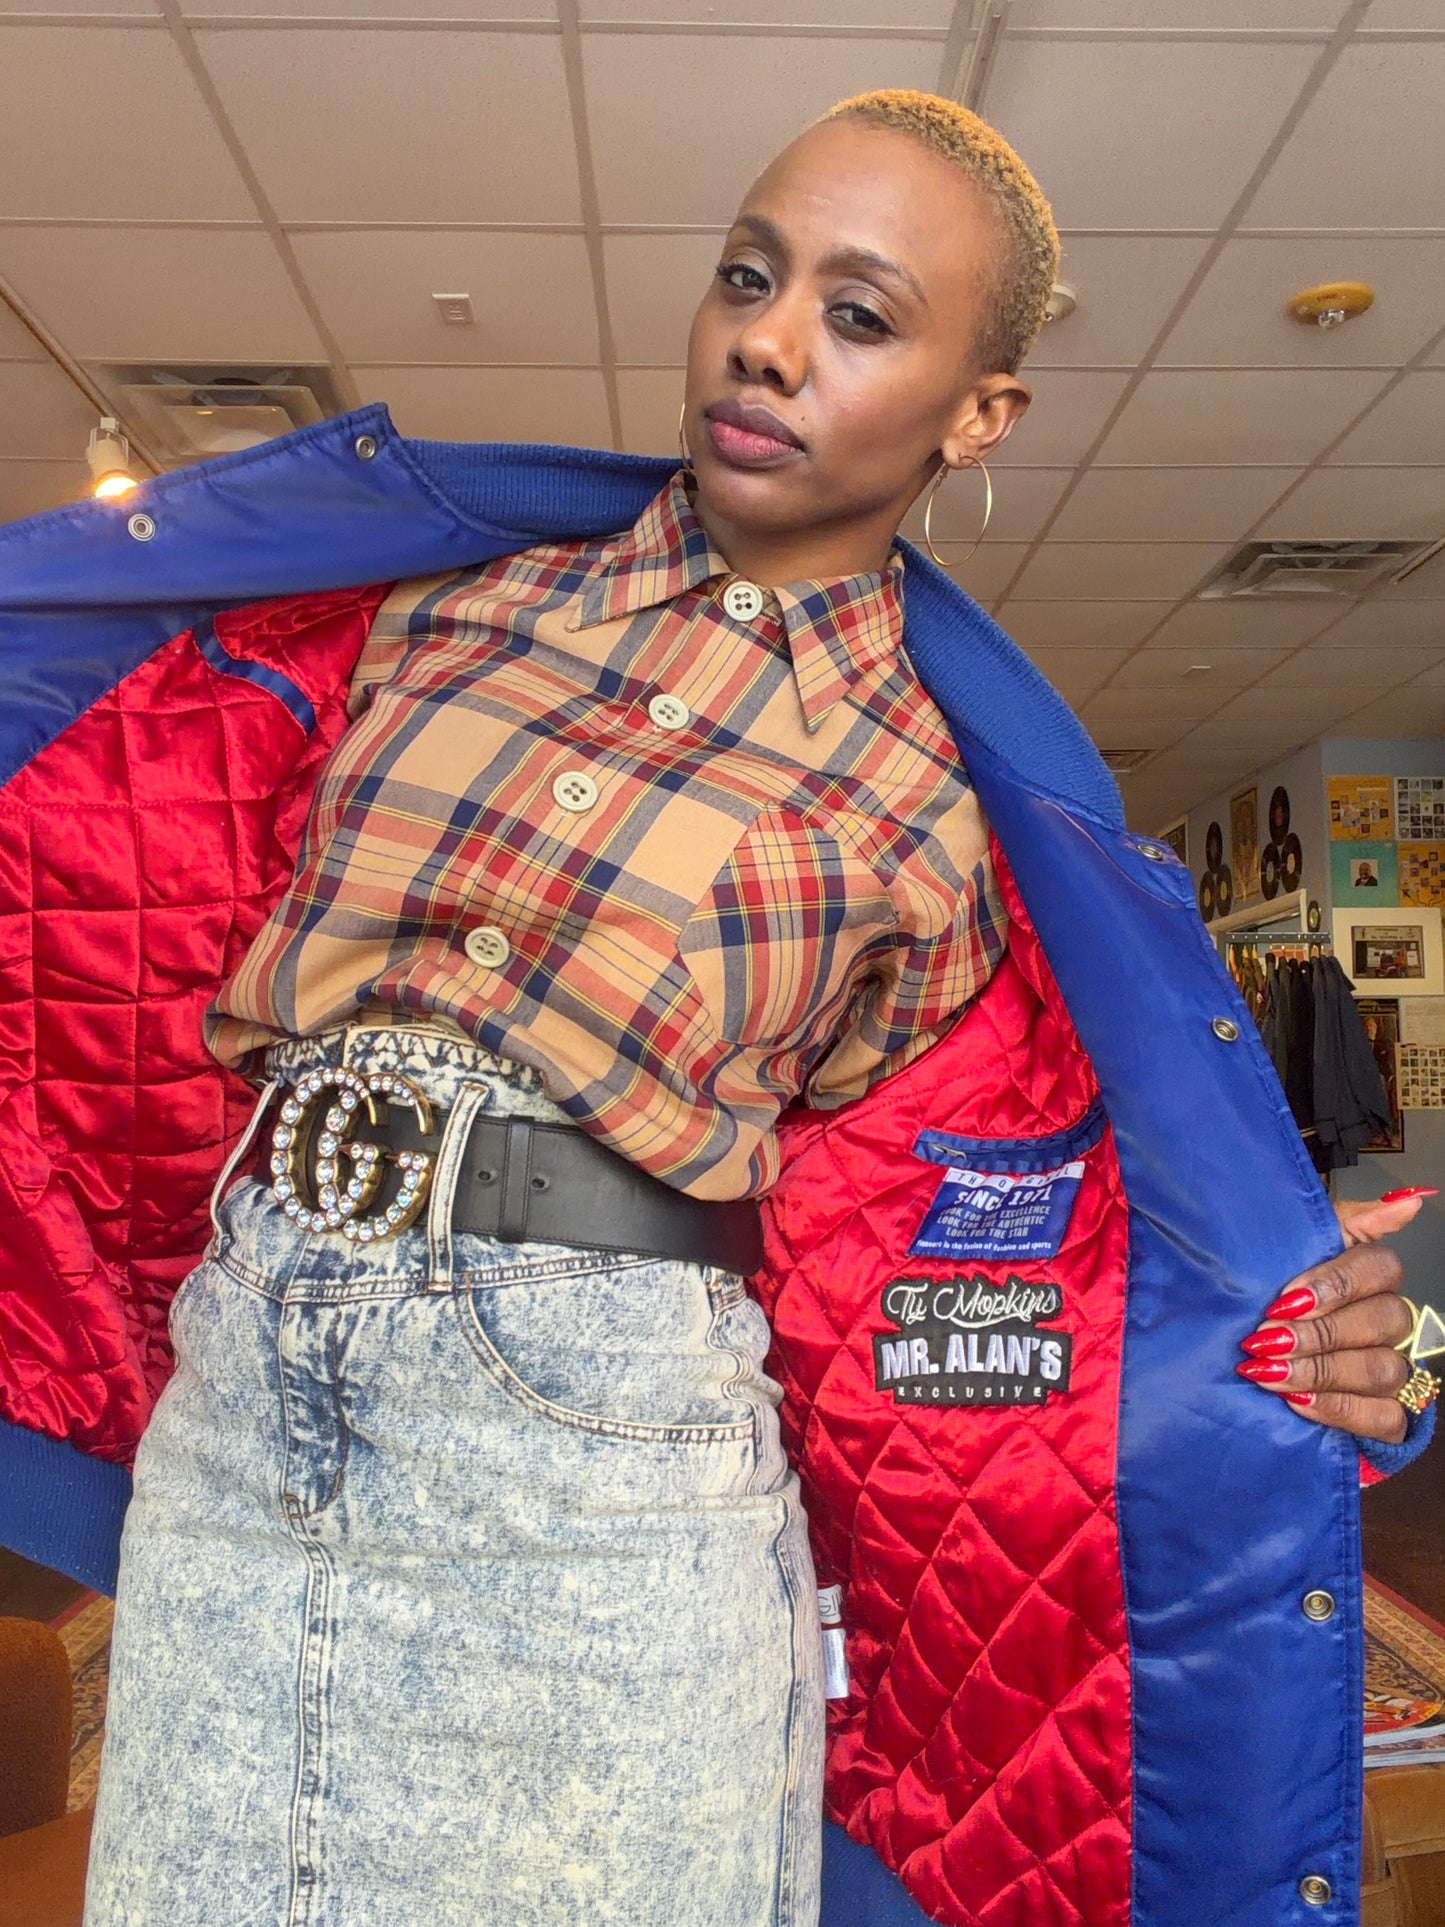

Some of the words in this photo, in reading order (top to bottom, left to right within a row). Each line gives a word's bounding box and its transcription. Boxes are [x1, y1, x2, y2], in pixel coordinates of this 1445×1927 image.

[1008, 1185, 1052, 1205] 1971
[936, 1215, 961, 1228] LOOK
[945, 1226, 969, 1238] LOOK
[989, 1227, 1007, 1239] THE
[1008, 1226, 1029, 1239] STAR
[881, 1337, 940, 1381] MR.
[944, 1333, 1063, 1382] ALAN'S
[897, 1385, 1042, 1399] EXCLUSIVE
